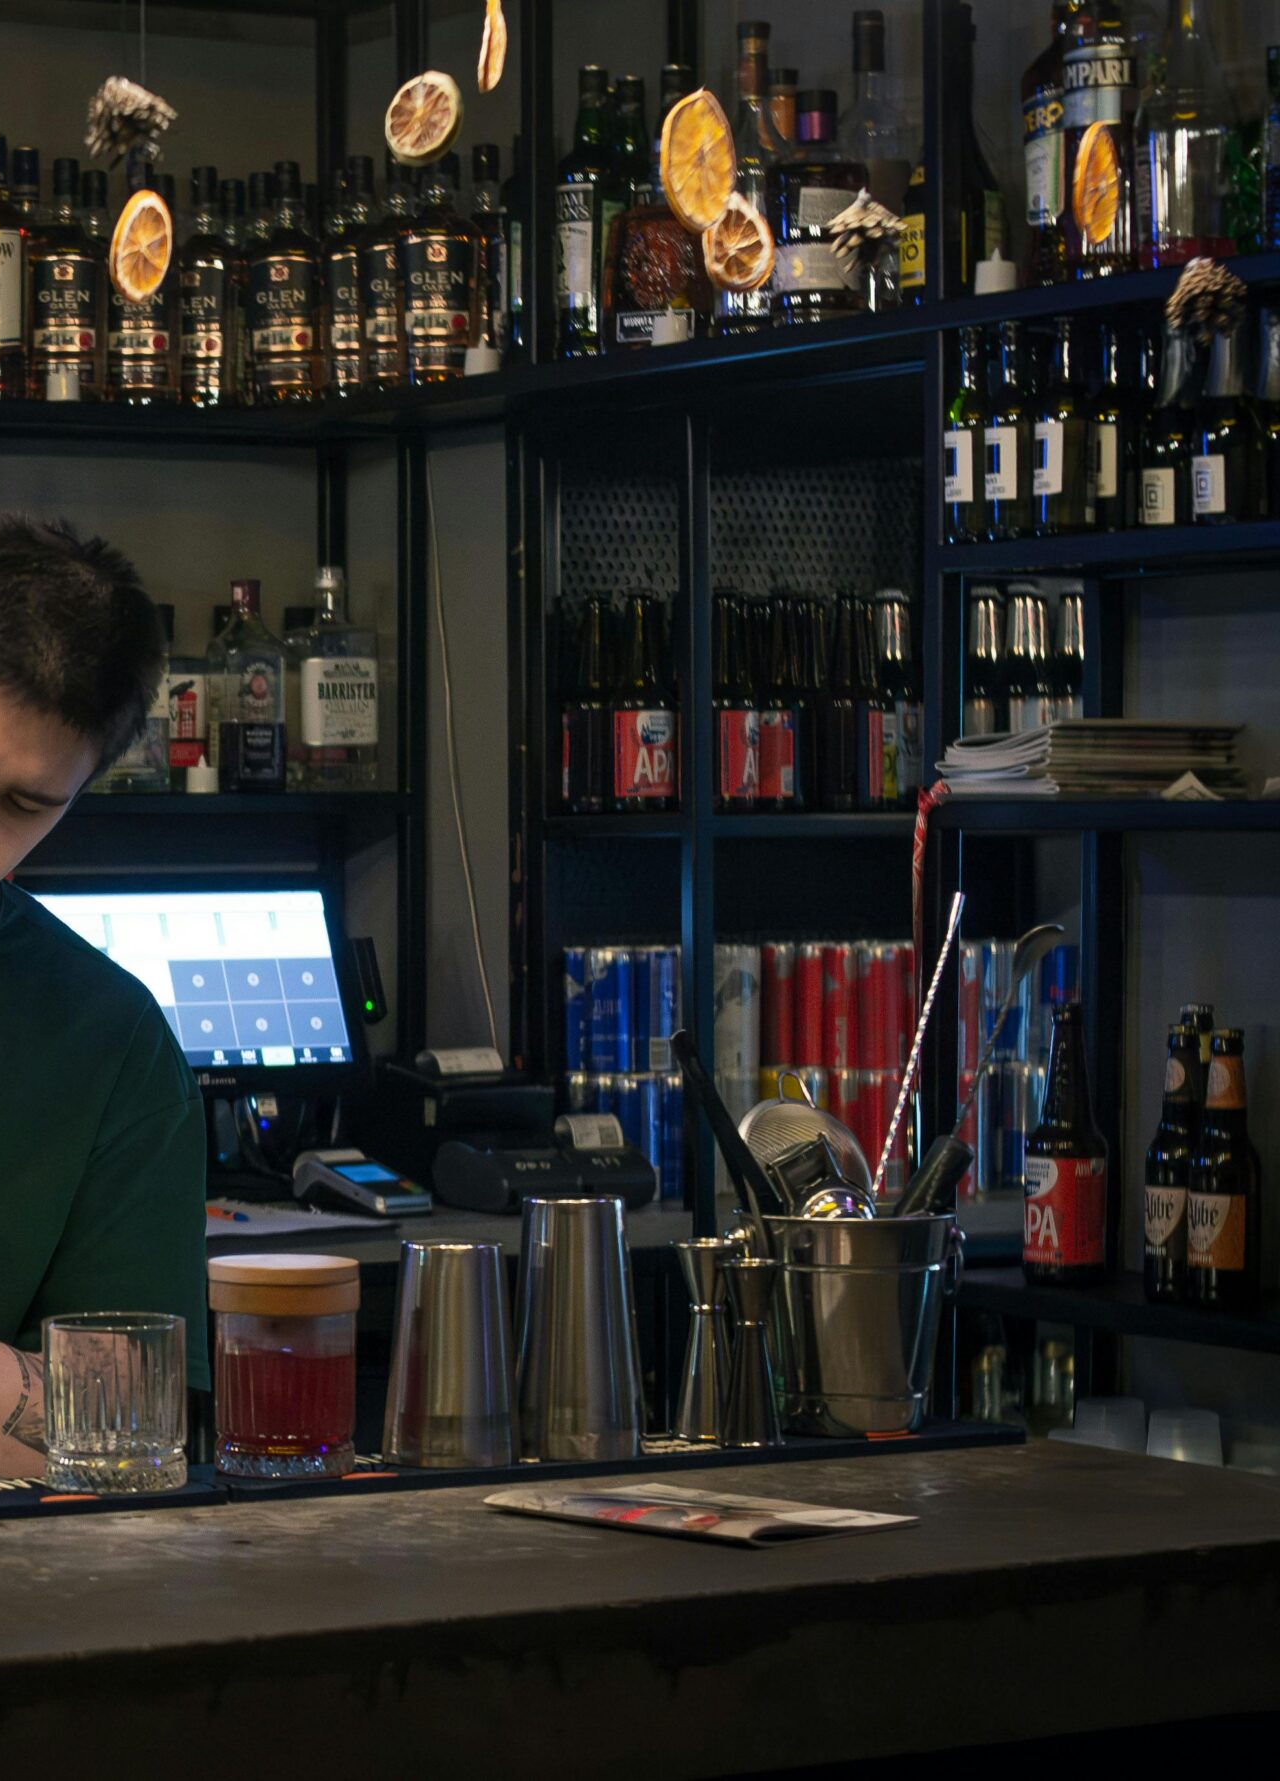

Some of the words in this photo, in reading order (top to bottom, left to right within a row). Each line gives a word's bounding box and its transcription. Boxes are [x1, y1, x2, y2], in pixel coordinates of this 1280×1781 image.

[410, 271, 464, 285] GLEN
[337, 286, 358, 299] GL
[371, 279, 397, 293] GL
[38, 290, 91, 303] GLEN
[113, 293, 164, 305] GN
[182, 295, 217, 309] LEN
[256, 289, 306, 305] GLEN
[318, 682, 376, 700] BARRISTER
